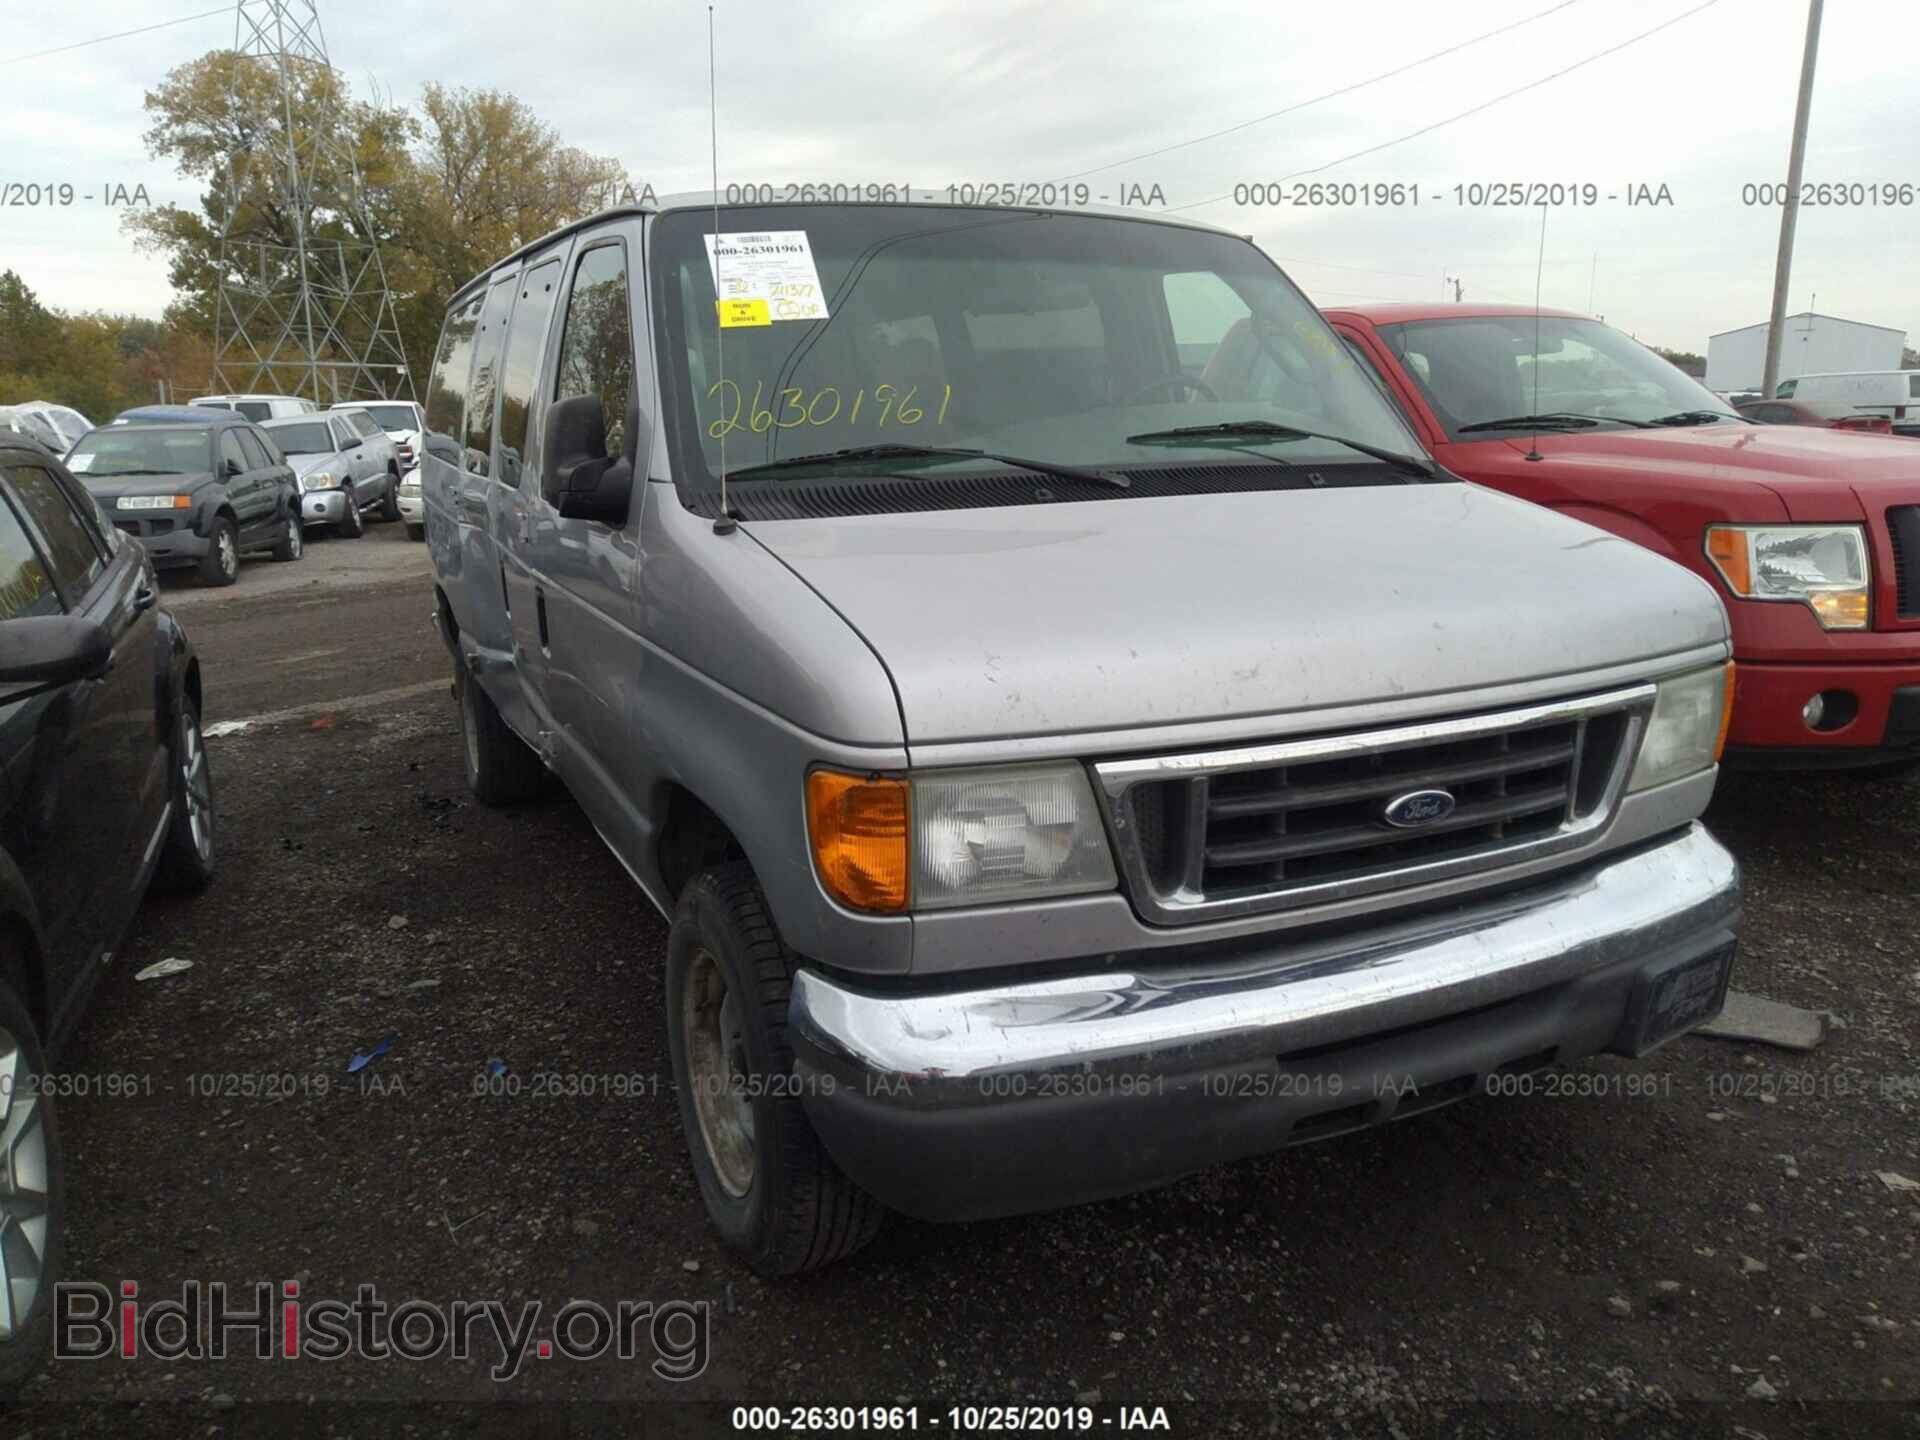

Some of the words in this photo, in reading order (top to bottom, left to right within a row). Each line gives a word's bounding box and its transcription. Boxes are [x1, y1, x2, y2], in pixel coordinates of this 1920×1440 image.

[713, 244, 804, 256] 000-26301961
[708, 379, 951, 438] 26301961
[1404, 798, 1441, 819] Ford
